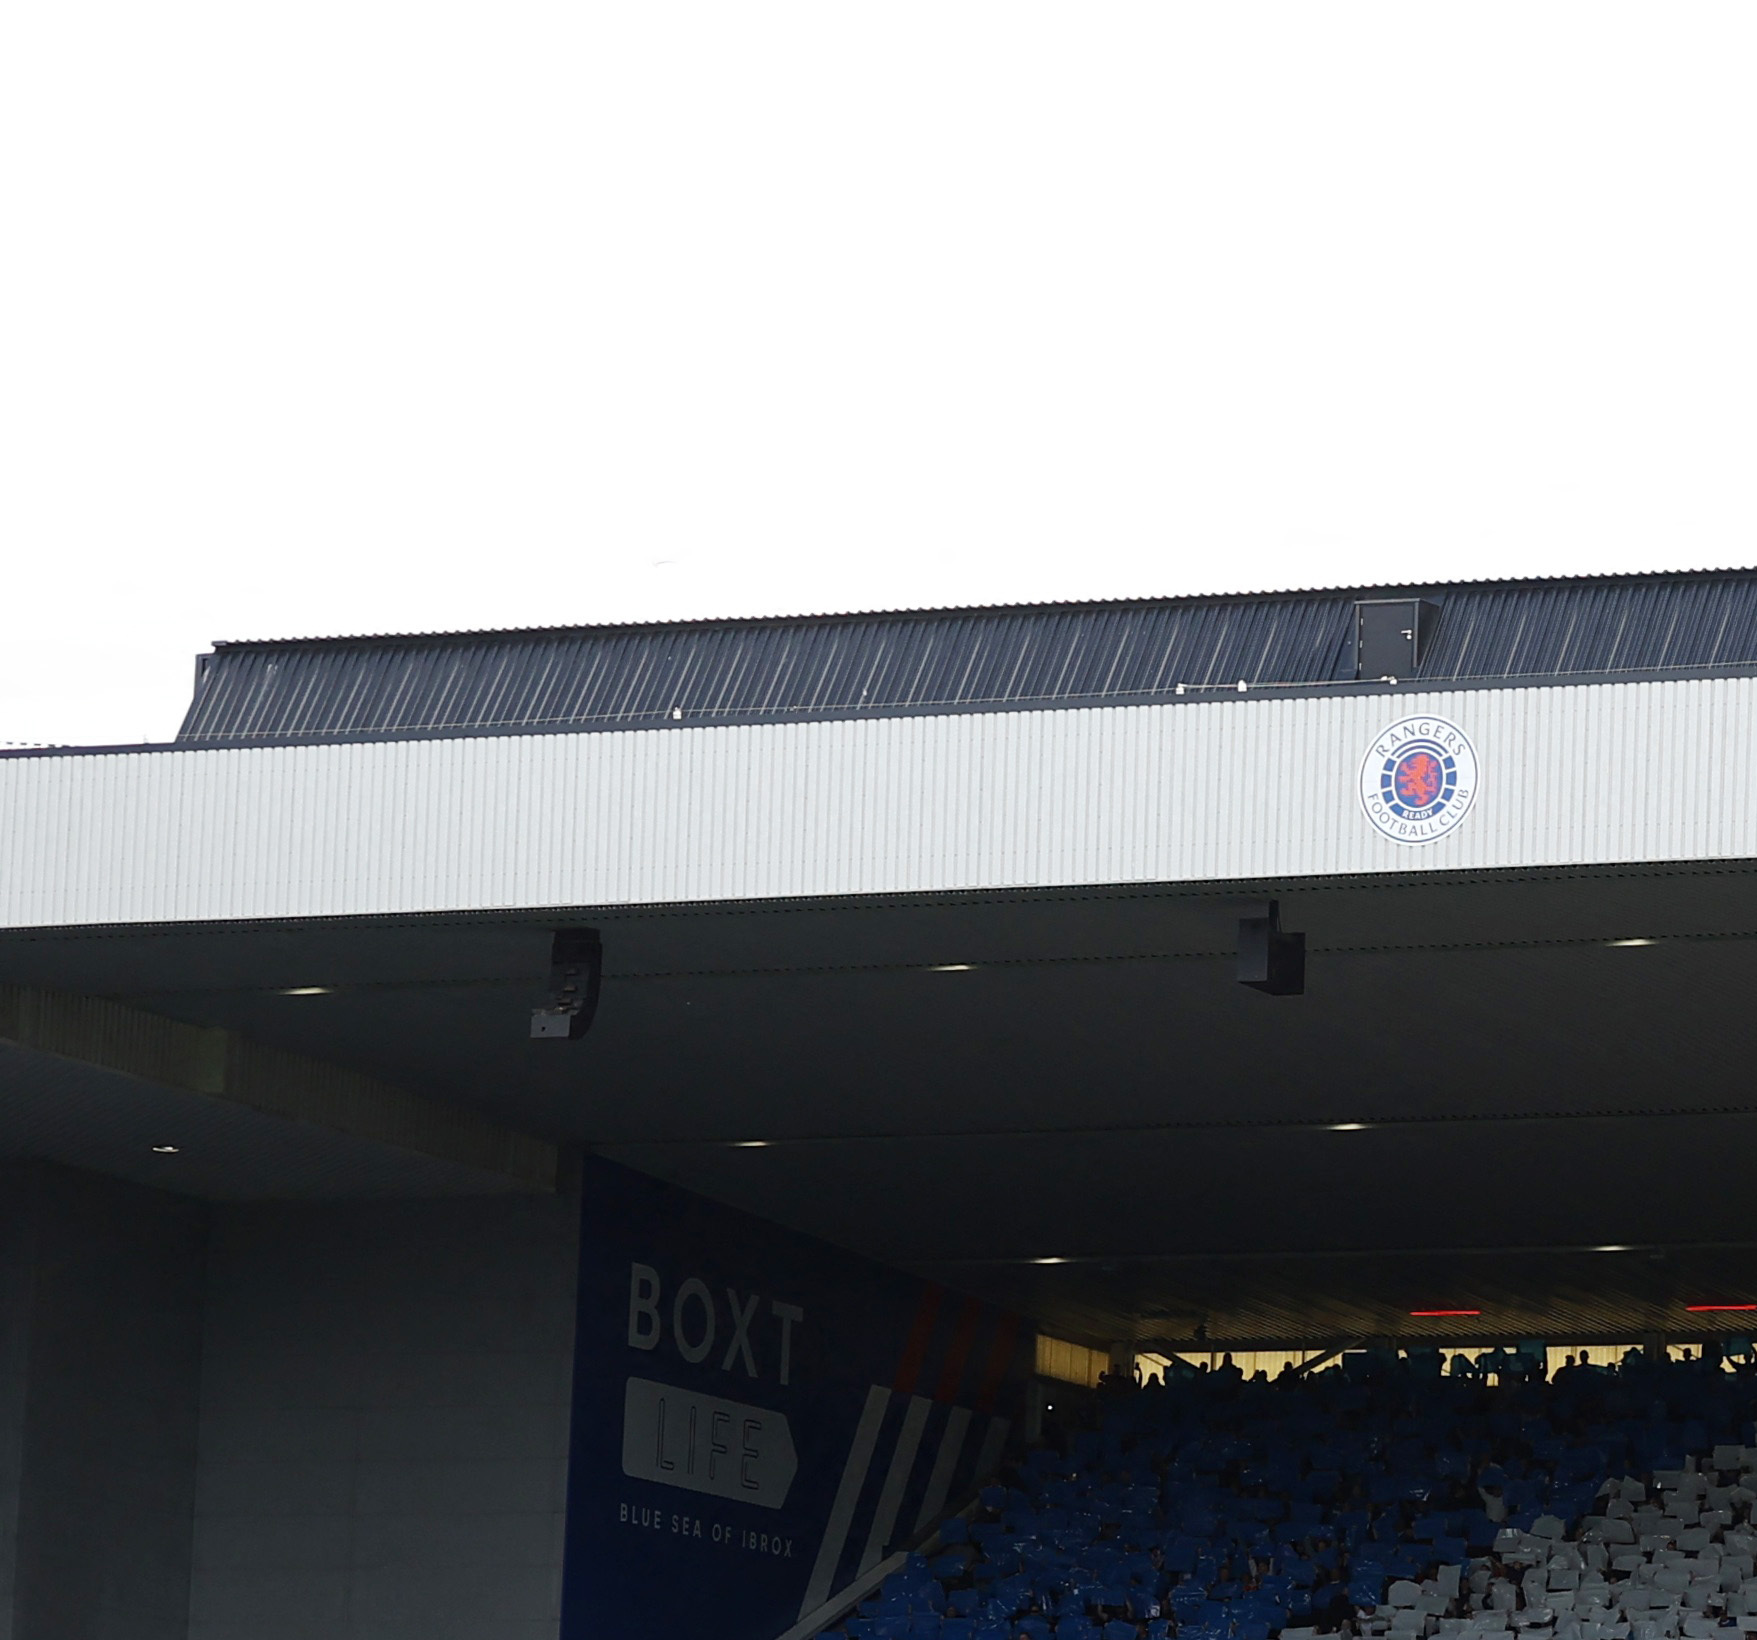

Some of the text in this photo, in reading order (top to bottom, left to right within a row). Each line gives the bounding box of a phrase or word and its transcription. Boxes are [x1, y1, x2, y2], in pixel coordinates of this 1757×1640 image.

[1375, 722, 1466, 758] RANGERS
[1367, 789, 1469, 837] FOOTBALL CLUB
[1402, 808, 1434, 820] READY
[627, 1261, 804, 1386] BOXT
[656, 1397, 762, 1490] LIFE
[619, 1502, 794, 1558] BLUE SEA OF IBROX
